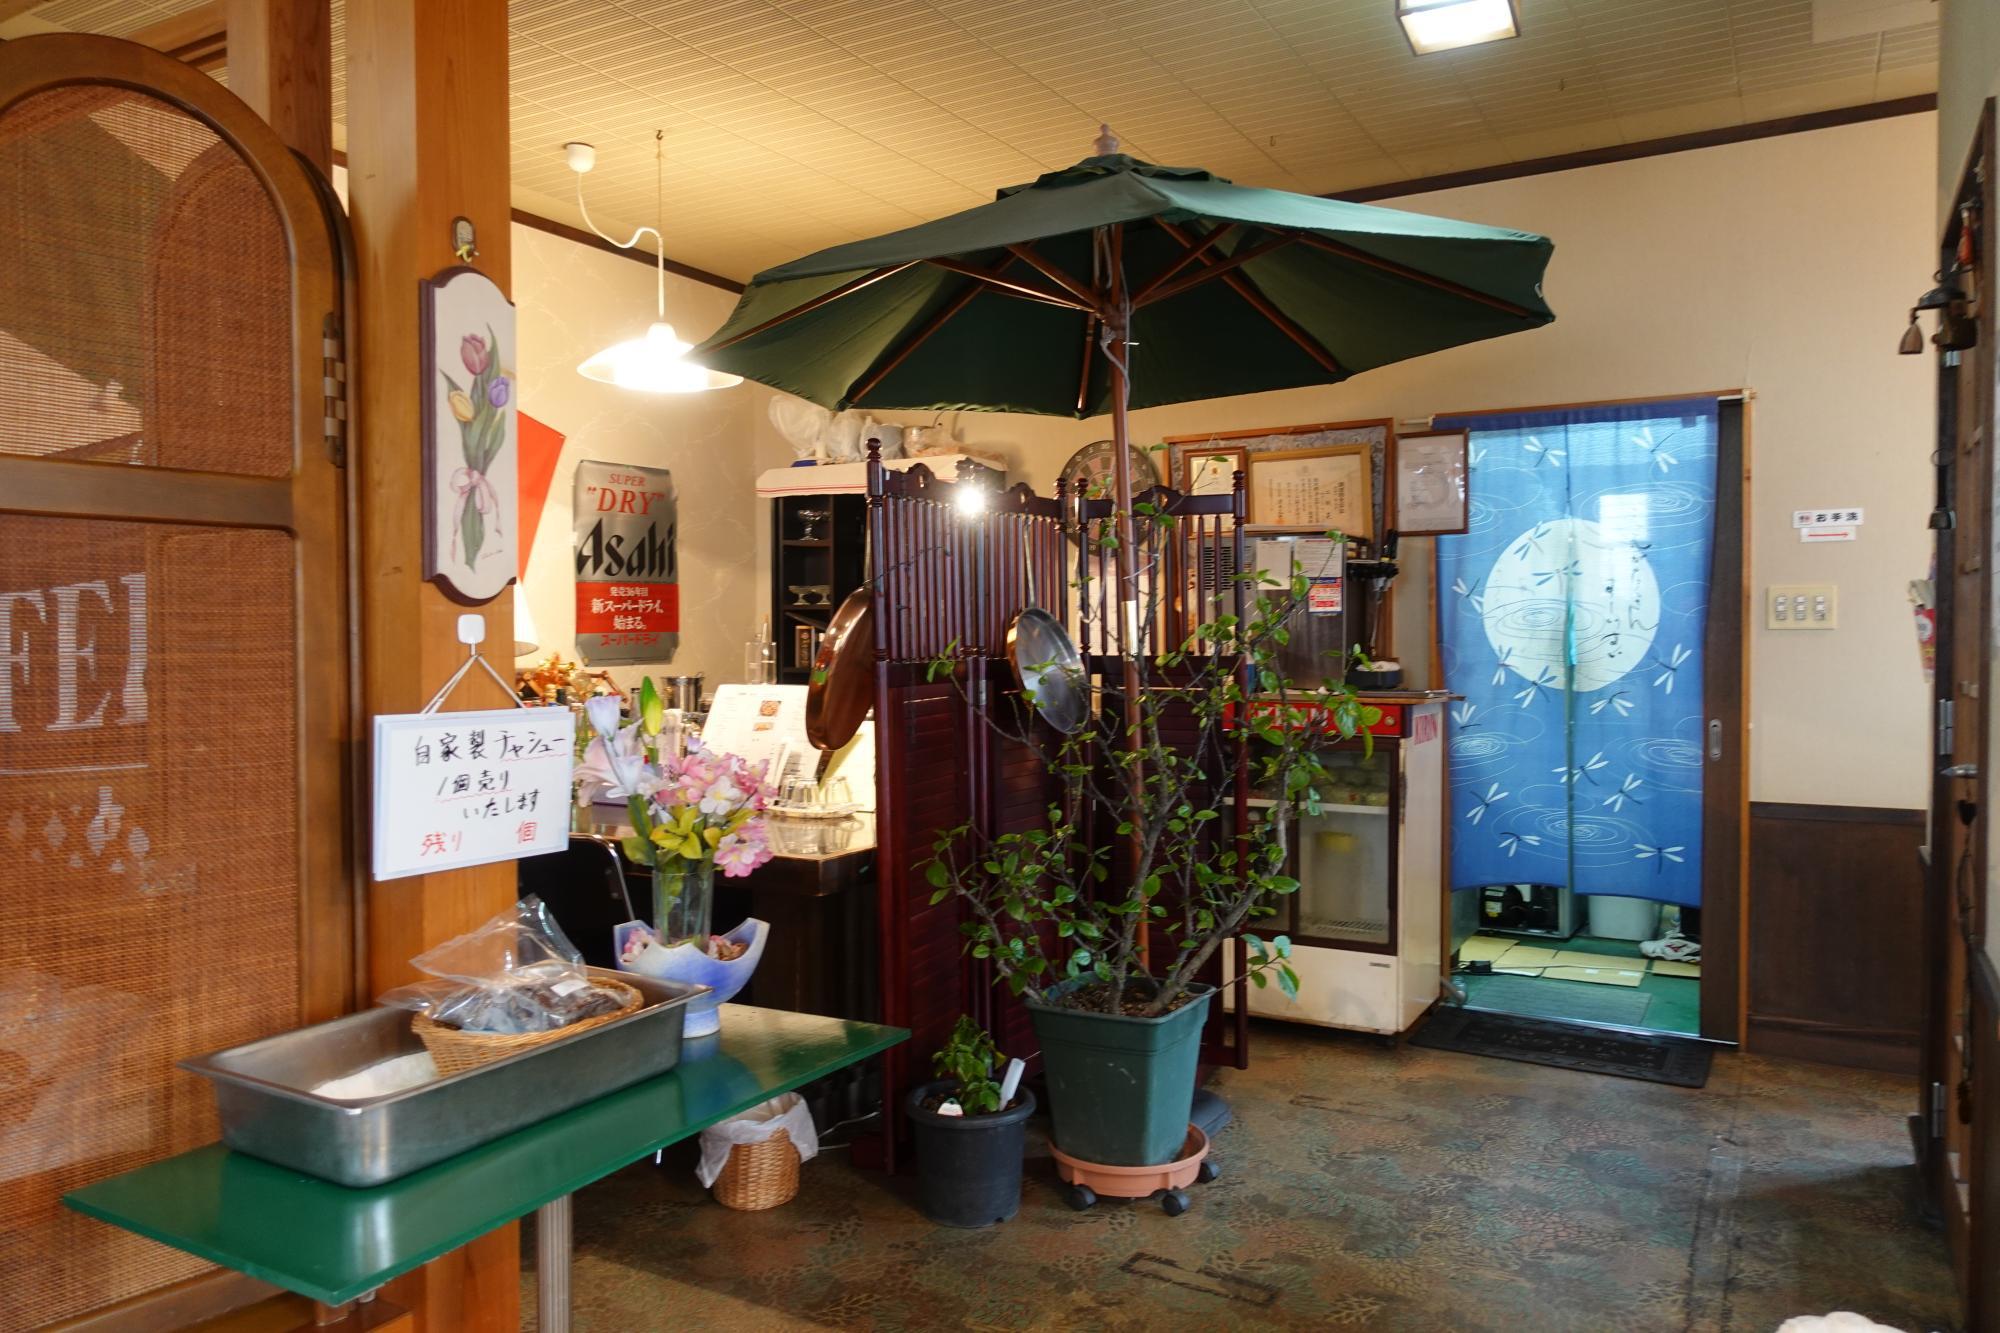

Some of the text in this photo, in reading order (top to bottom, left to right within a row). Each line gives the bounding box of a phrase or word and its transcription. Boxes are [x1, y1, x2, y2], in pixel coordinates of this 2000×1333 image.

[608, 473, 646, 486] SUPER
[576, 517, 675, 577] Asahi
[613, 615, 647, 630] 始まる。
[462, 789, 541, 820] いたします
[516, 821, 538, 844] 個
